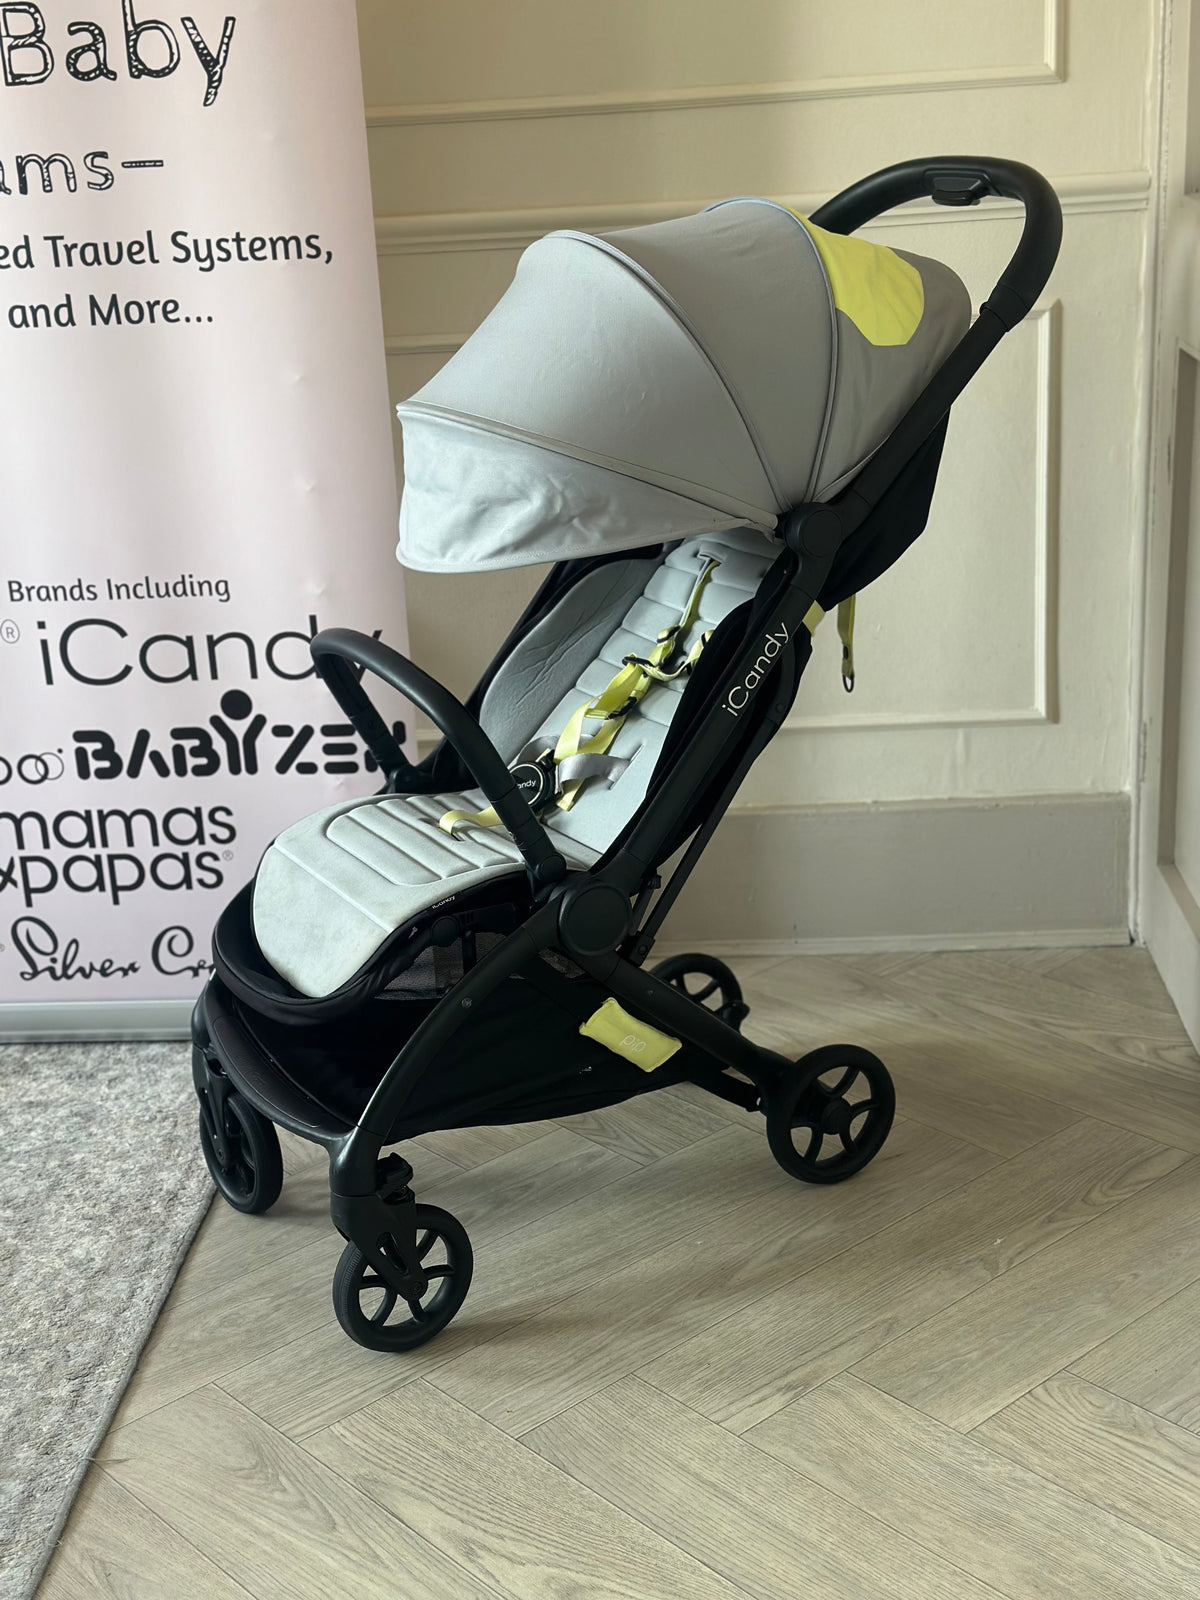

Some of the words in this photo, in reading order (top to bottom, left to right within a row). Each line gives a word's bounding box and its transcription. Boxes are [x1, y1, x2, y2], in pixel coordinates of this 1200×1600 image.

[0, 0, 236, 107] Baby
[43, 230, 160, 268] Travel
[171, 230, 333, 272] Systems,
[8, 293, 77, 328] and
[89, 293, 213, 326] More...
[8, 578, 98, 602] Brands
[106, 574, 230, 603] Including
[721, 622, 789, 717] iCandy
[0, 806, 237, 850] mamas
[10, 915, 141, 981] Silver
